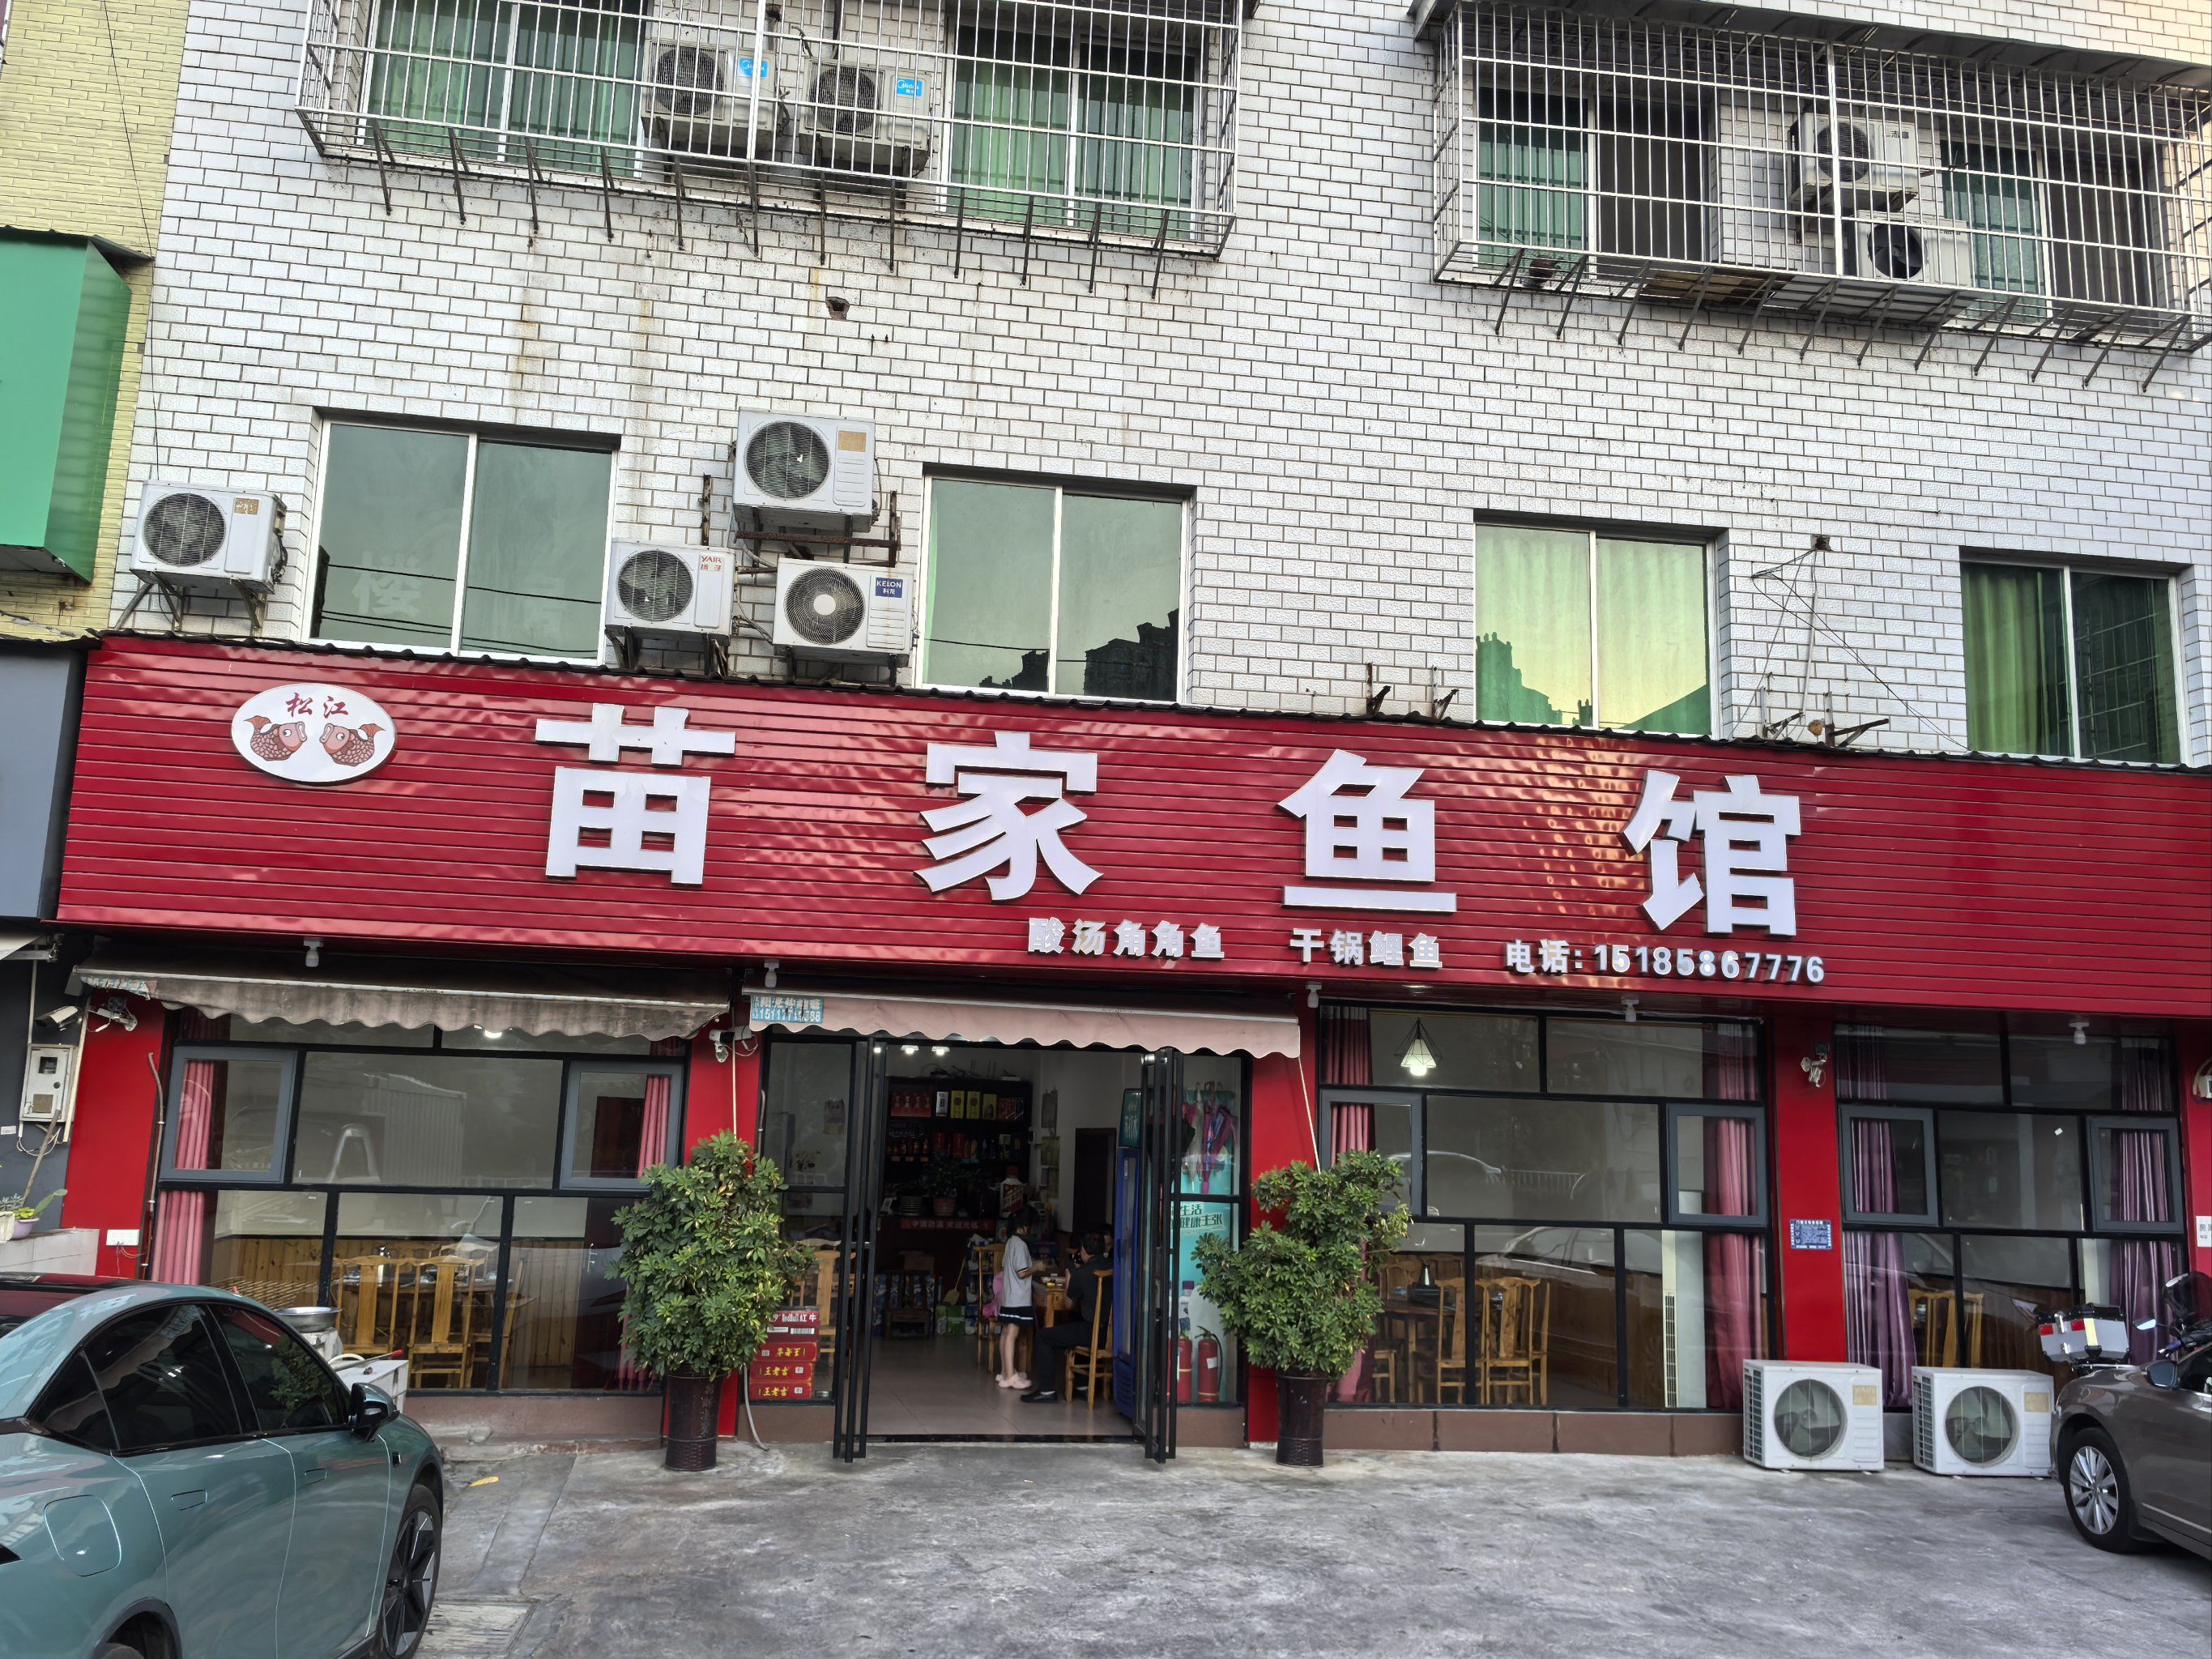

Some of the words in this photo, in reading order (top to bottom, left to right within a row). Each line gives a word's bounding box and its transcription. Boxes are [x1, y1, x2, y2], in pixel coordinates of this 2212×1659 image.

[876, 580, 901, 588] KELON
[286, 693, 348, 719] 松江
[535, 702, 1801, 936] 苗家鱼馆
[1028, 917, 1225, 958] 酸汤角角鱼
[1290, 928, 1443, 967] 干锅鲤鱼
[1171, 1204, 1202, 1216] 生活
[1171, 1213, 1223, 1228] 健康主张
[765, 1366, 789, 1376] 王老吉
[763, 1387, 788, 1397] 王老吉
